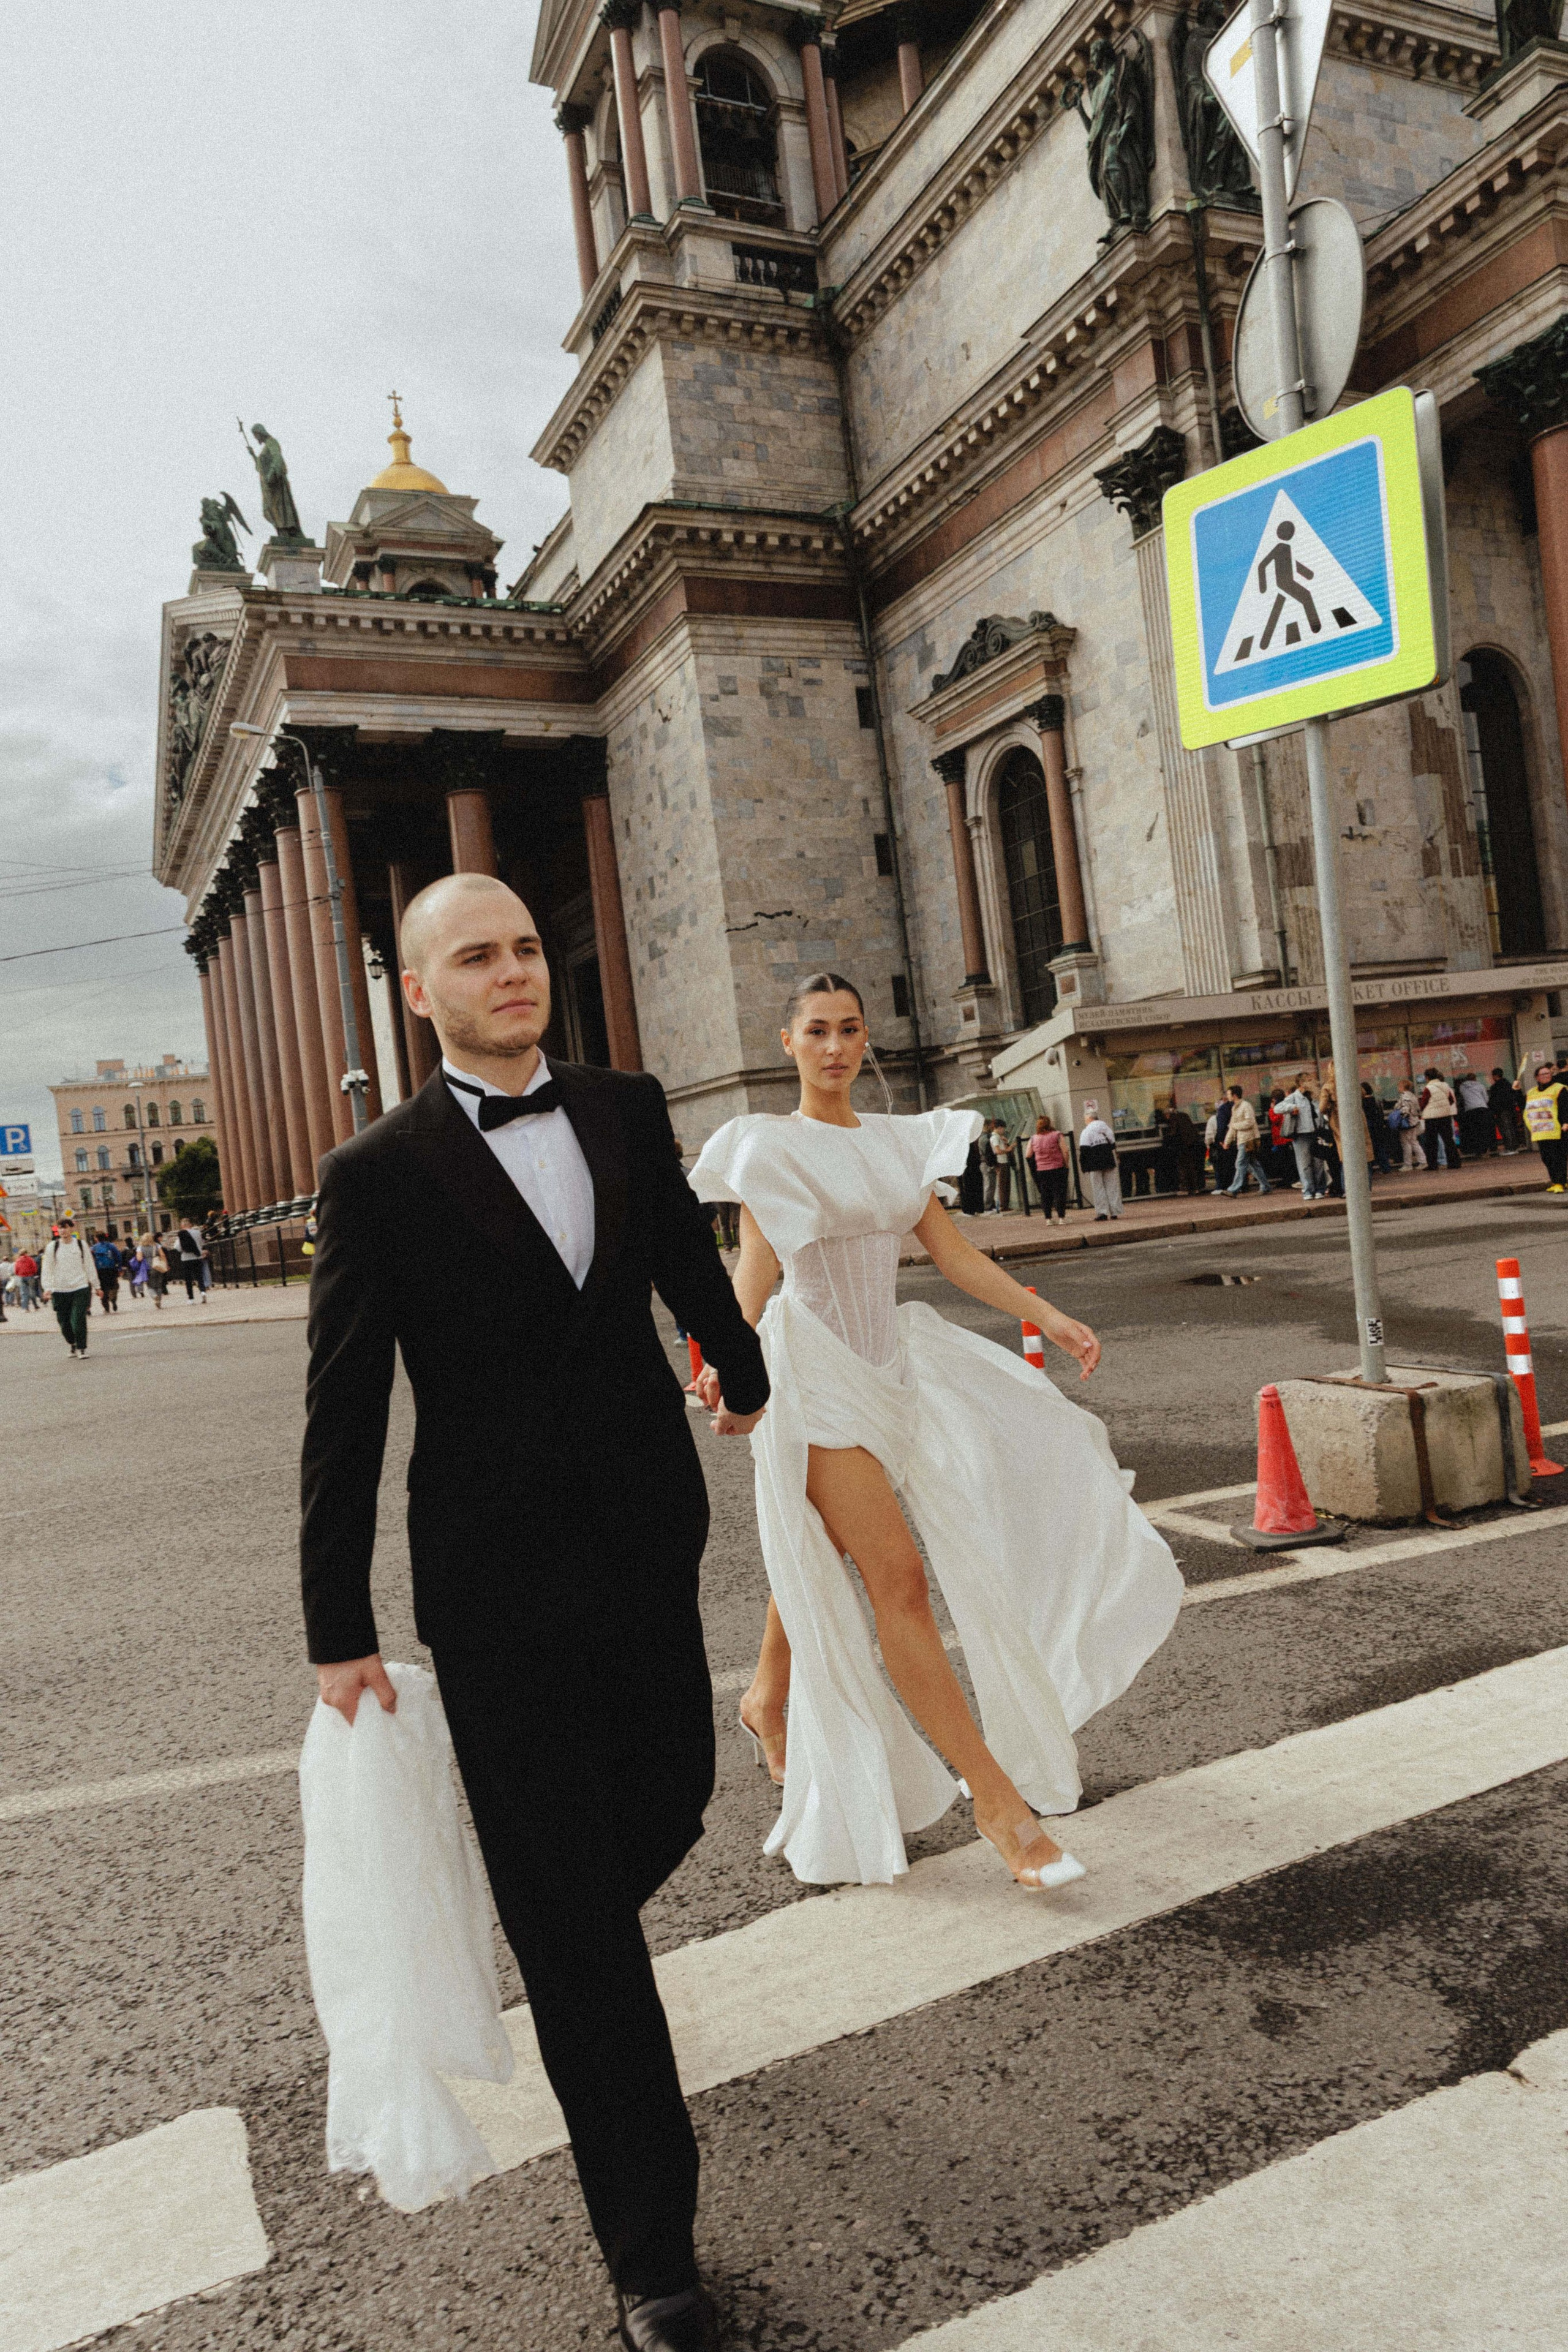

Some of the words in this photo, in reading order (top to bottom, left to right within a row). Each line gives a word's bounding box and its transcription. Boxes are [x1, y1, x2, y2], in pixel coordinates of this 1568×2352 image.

[1391, 978, 1450, 997] OFFICE
[1251, 990, 1312, 1011] КАССЫ
[5, 1128, 26, 1152] P
